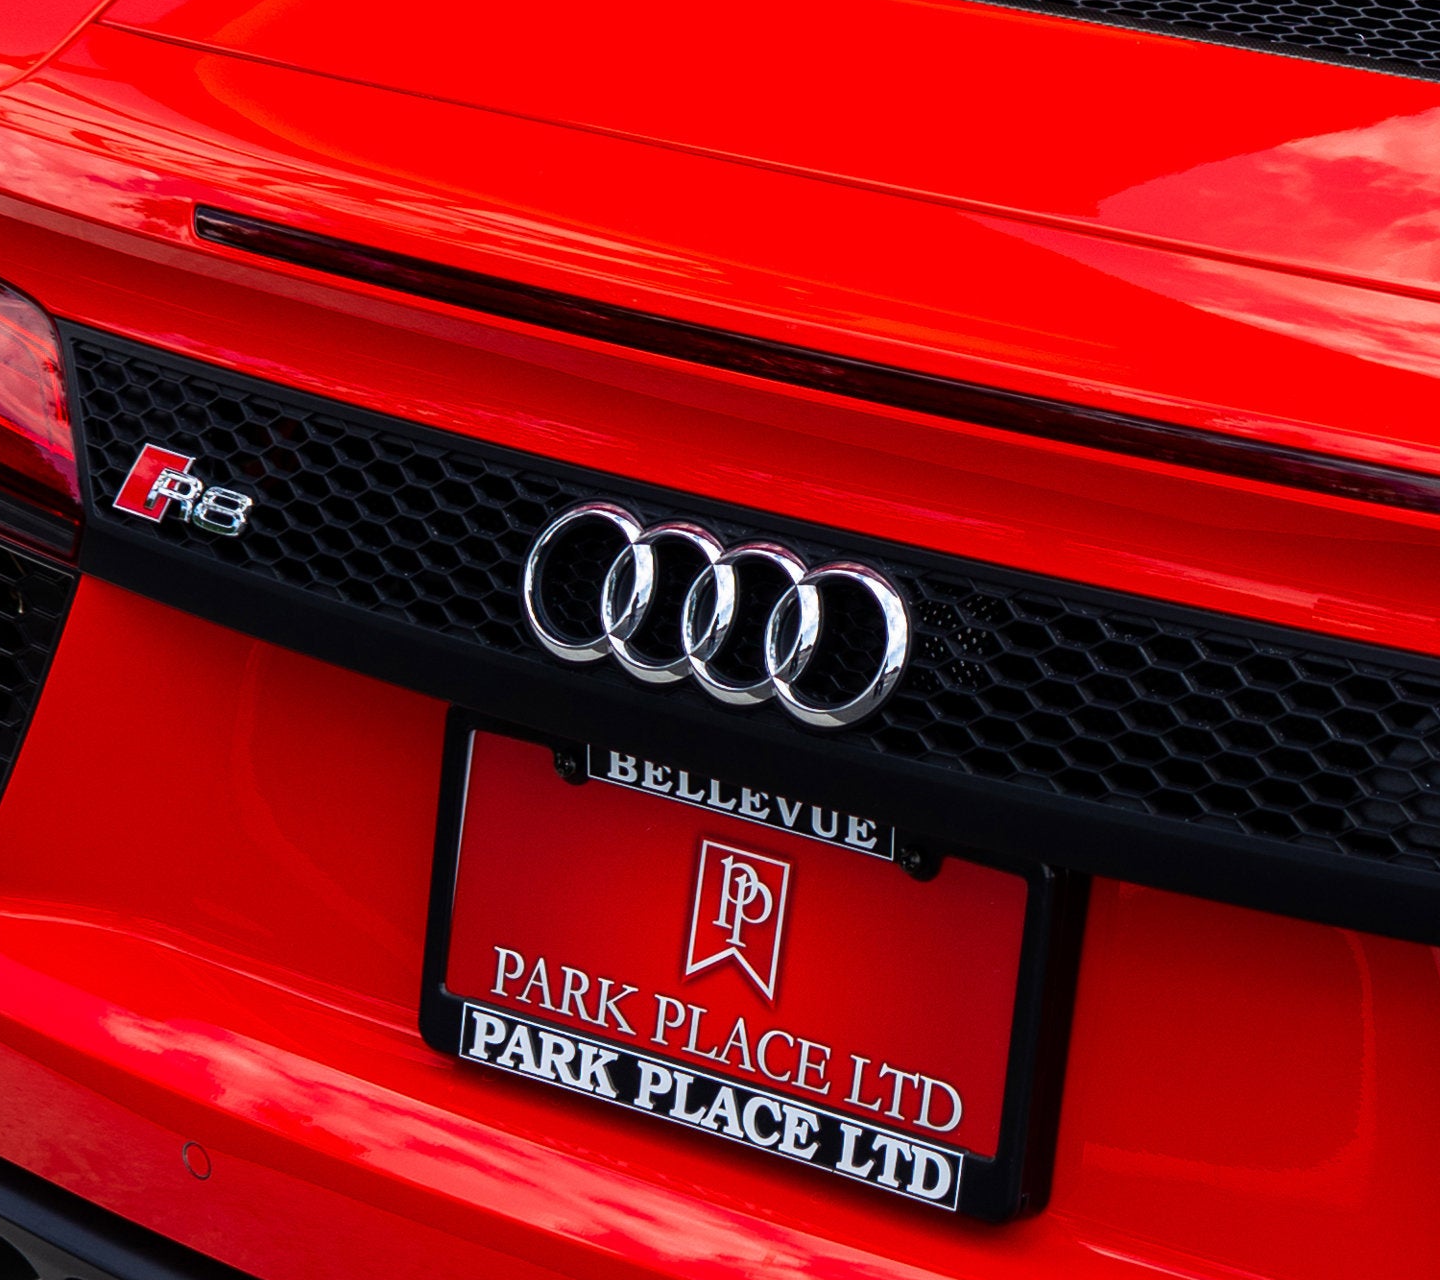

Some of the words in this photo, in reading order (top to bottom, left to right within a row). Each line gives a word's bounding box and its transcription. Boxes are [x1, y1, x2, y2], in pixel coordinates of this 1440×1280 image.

[142, 466, 254, 538] R8
[607, 750, 877, 849] BELLEVUE
[469, 1010, 619, 1099] PARK
[633, 1060, 820, 1160] PLACE
[835, 1122, 953, 1201] LTD
[490, 946, 639, 1035] PARK
[650, 994, 831, 1094] PLACE
[844, 1054, 962, 1132] LTD
